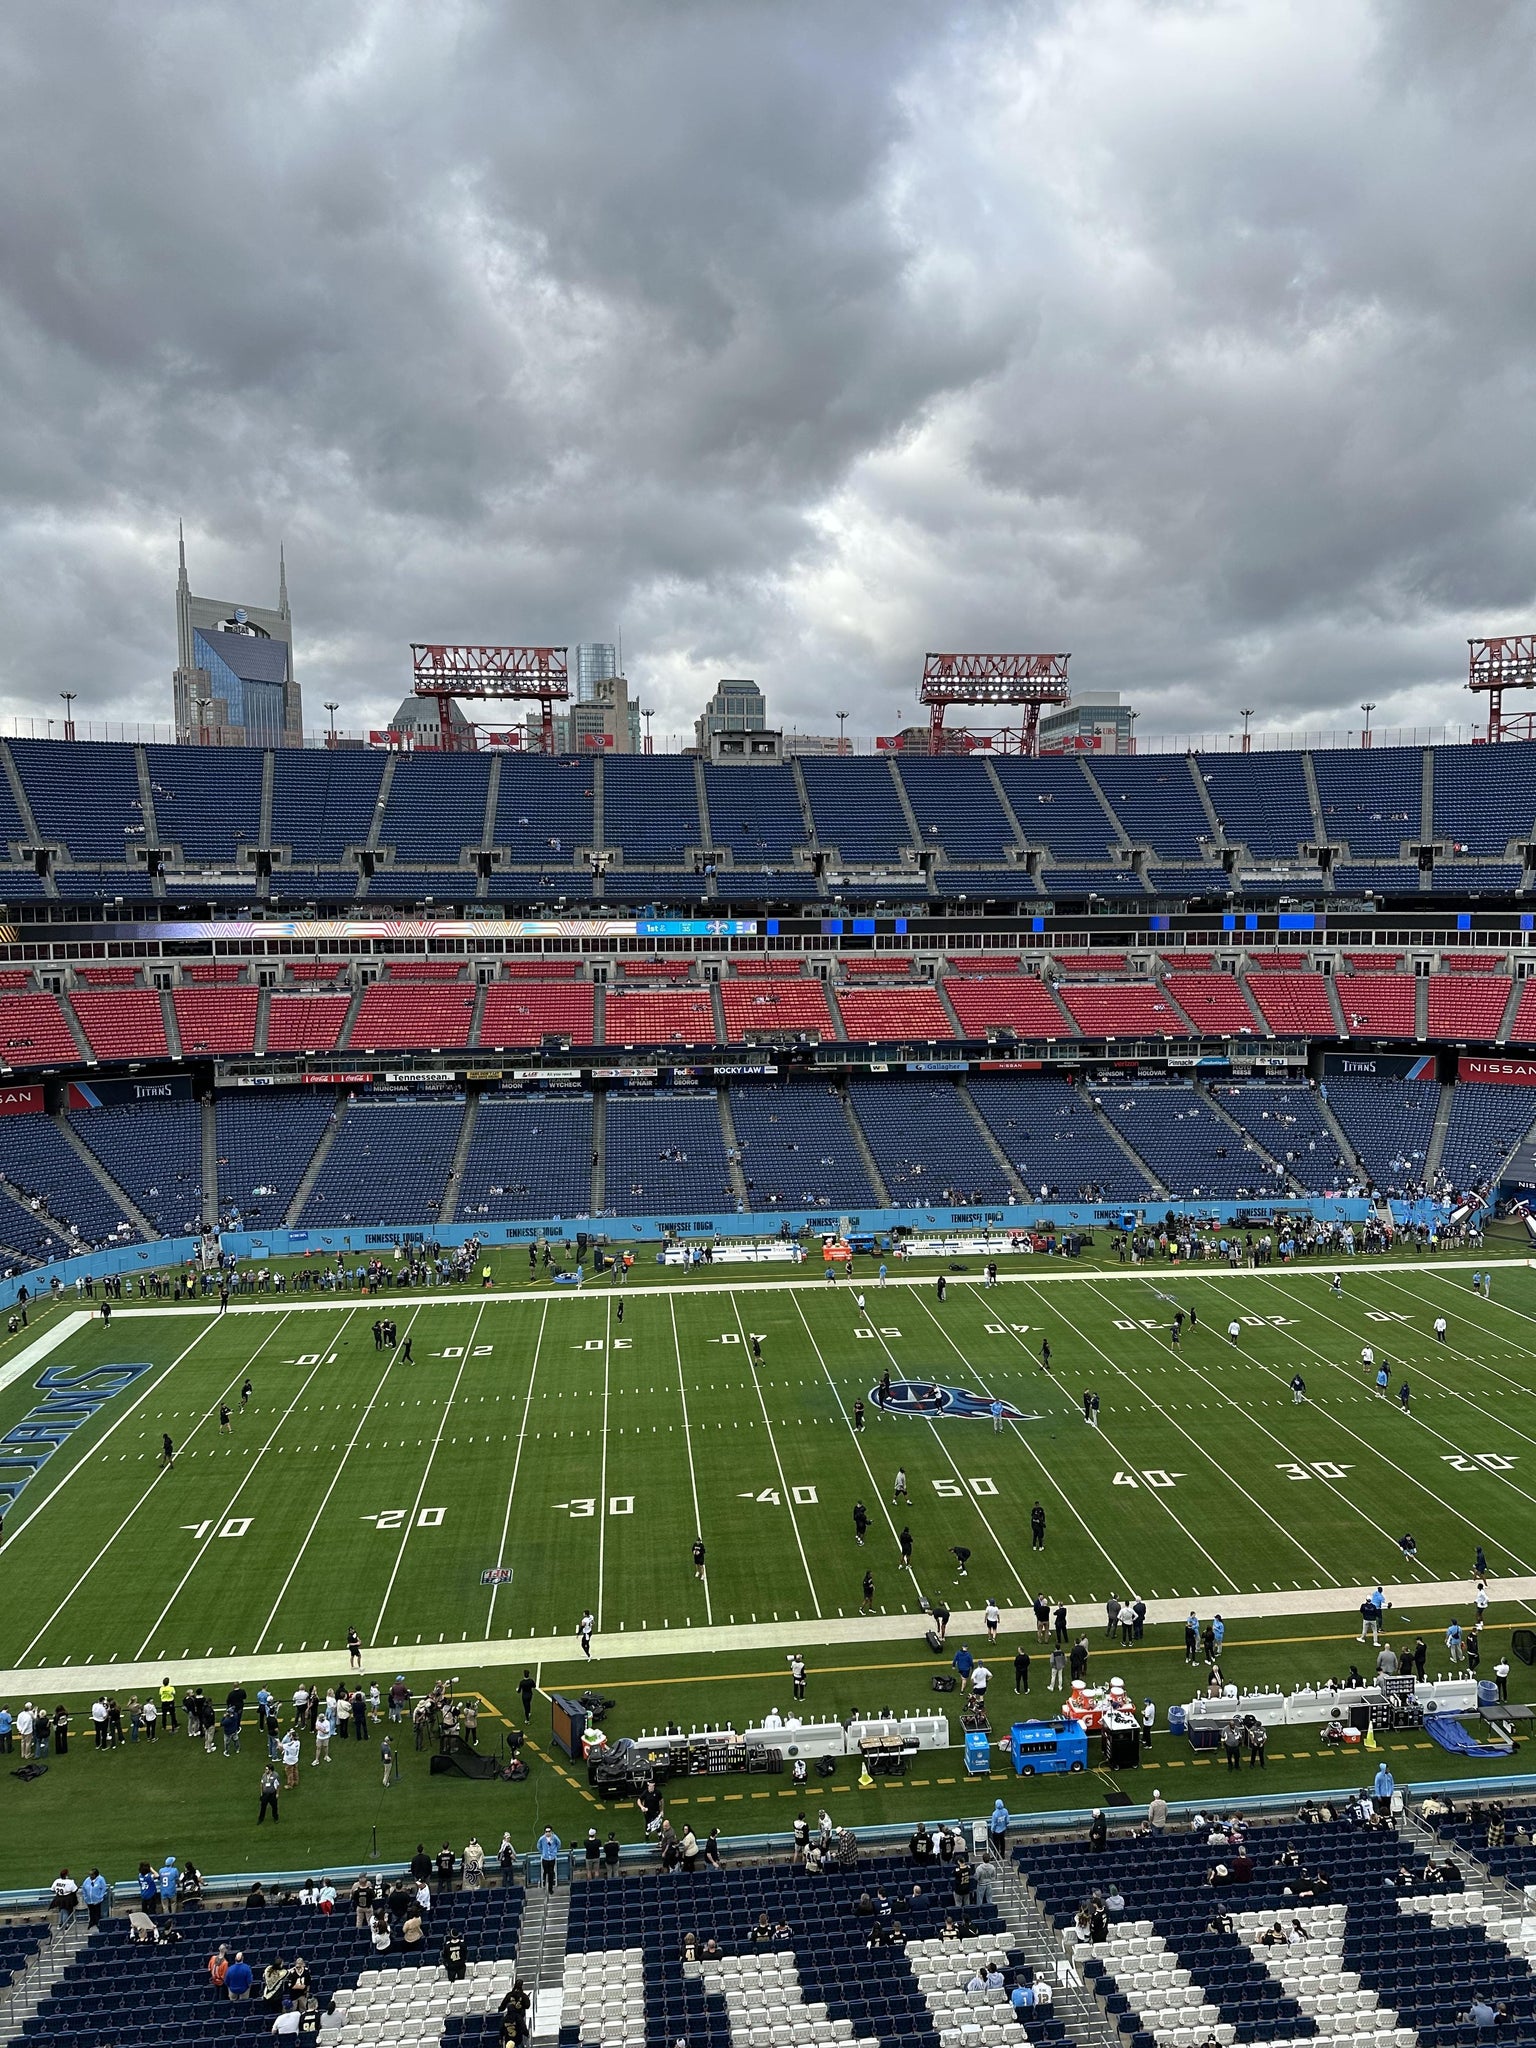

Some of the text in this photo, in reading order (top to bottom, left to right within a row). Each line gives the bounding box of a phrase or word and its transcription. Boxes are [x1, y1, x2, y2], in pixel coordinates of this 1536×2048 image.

[647, 924, 659, 932] 1st
[674, 1067, 695, 1076] FedEx
[744, 1066, 761, 1074] LAW
[1342, 1060, 1376, 1072] TITANS
[1469, 1063, 1536, 1075] NISSAN
[134, 1083, 172, 1098] TITANS
[0, 1092, 31, 1104] AN
[951, 1213, 983, 1223] TENNESSEE
[1236, 1207, 1268, 1218] TENNESSEE
[506, 1227, 538, 1238] TENNESSE
[658, 1221, 713, 1232] TENNESSEE TOUGH
[365, 1232, 424, 1244] TENNESSEE TOUGH
[1112, 1319, 1165, 1330] 30
[1239, 1315, 1294, 1326] 20
[853, 1327, 902, 1339] 50
[984, 1323, 1029, 1334] 40
[584, 1337, 633, 1351] 30
[434, 1345, 493, 1358] 20
[1440, 1453, 1515, 1472] 20
[1274, 1461, 1348, 1482] 30
[1112, 1470, 1177, 1488] 40
[931, 1477, 1000, 1497] 50
[756, 1486, 819, 1506] 40
[569, 1495, 635, 1518] 30
[376, 1507, 448, 1530] 20
[193, 1517, 255, 1540] 10
[162, 1876, 168, 1887] 9
[960, 1876, 970, 1885] 12
[450, 1951, 461, 1961] 41
[685, 1949, 695, 1961] 41
